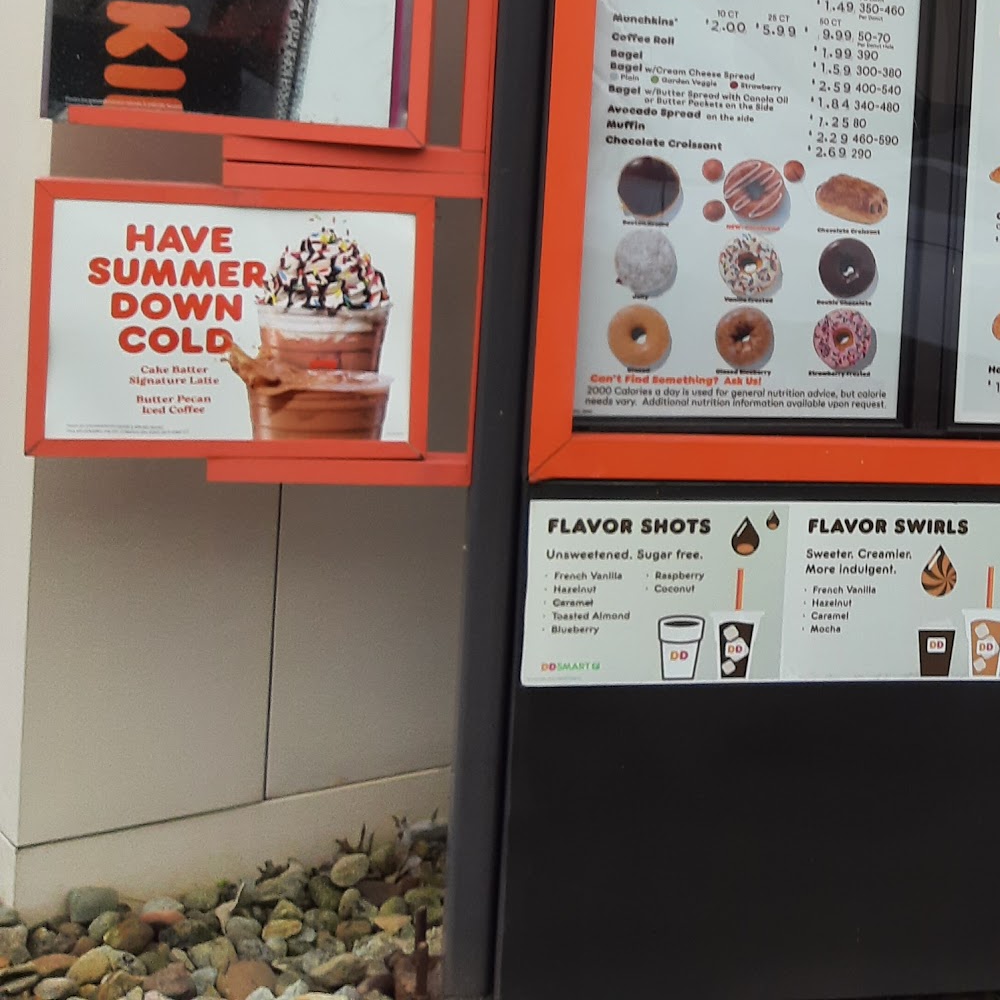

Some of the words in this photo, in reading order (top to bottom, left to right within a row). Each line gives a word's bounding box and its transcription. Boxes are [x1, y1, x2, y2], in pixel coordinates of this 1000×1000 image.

[610, 50, 643, 61] Bagel
[607, 105, 657, 117] Avocado
[661, 109, 701, 120] Spread
[606, 120, 645, 131] Muffin
[605, 136, 665, 148] Chocolate
[668, 140, 723, 151] Croissant
[126, 223, 233, 253] HAVE
[88, 257, 267, 289] SUMMER
[110, 292, 242, 322] DOWN
[118, 326, 233, 355] COLD
[141, 364, 167, 375] Cake
[172, 364, 209, 375] Batter
[129, 375, 187, 387] Signature
[190, 375, 220, 386] Latte
[590, 374, 623, 384] Can't
[624, 375, 650, 384] Find
[652, 375, 720, 387] Something?
[723, 376, 740, 386] Ask
[136, 394, 173, 405] Butter
[177, 394, 212, 405] Pecan
[142, 405, 165, 415] Iced
[169, 405, 205, 415] Coffee
[548, 518, 633, 534] FLAVOR
[640, 518, 712, 535] SHOTS
[808, 518, 888, 534] FLAVOR
[893, 518, 969, 535] SWIRLS
[545, 548, 633, 561] Unsweetened.
[636, 549, 672, 563] Sugar
[675, 549, 704, 561] free.
[806, 548, 855, 561] Sweeter.
[857, 548, 913, 561] Creamier.
[554, 570, 588, 581] French
[590, 571, 624, 581] Vanilla
[805, 564, 836, 575] More
[839, 564, 897, 577] indulgent.
[654, 571, 705, 583] Raspberry
[553, 583, 597, 594] Hazelnut
[654, 583, 696, 594] Coconut
[813, 584, 844, 595] French
[846, 584, 877, 595] Vanilla
[552, 597, 594, 608] Caramel
[811, 598, 852, 609] Hazelnut
[551, 610, 590, 621] Toasted
[592, 610, 631, 621] Almond
[810, 611, 850, 622] Caramel
[550, 624, 600, 636] Blueberry
[810, 625, 841, 635] Mocha
